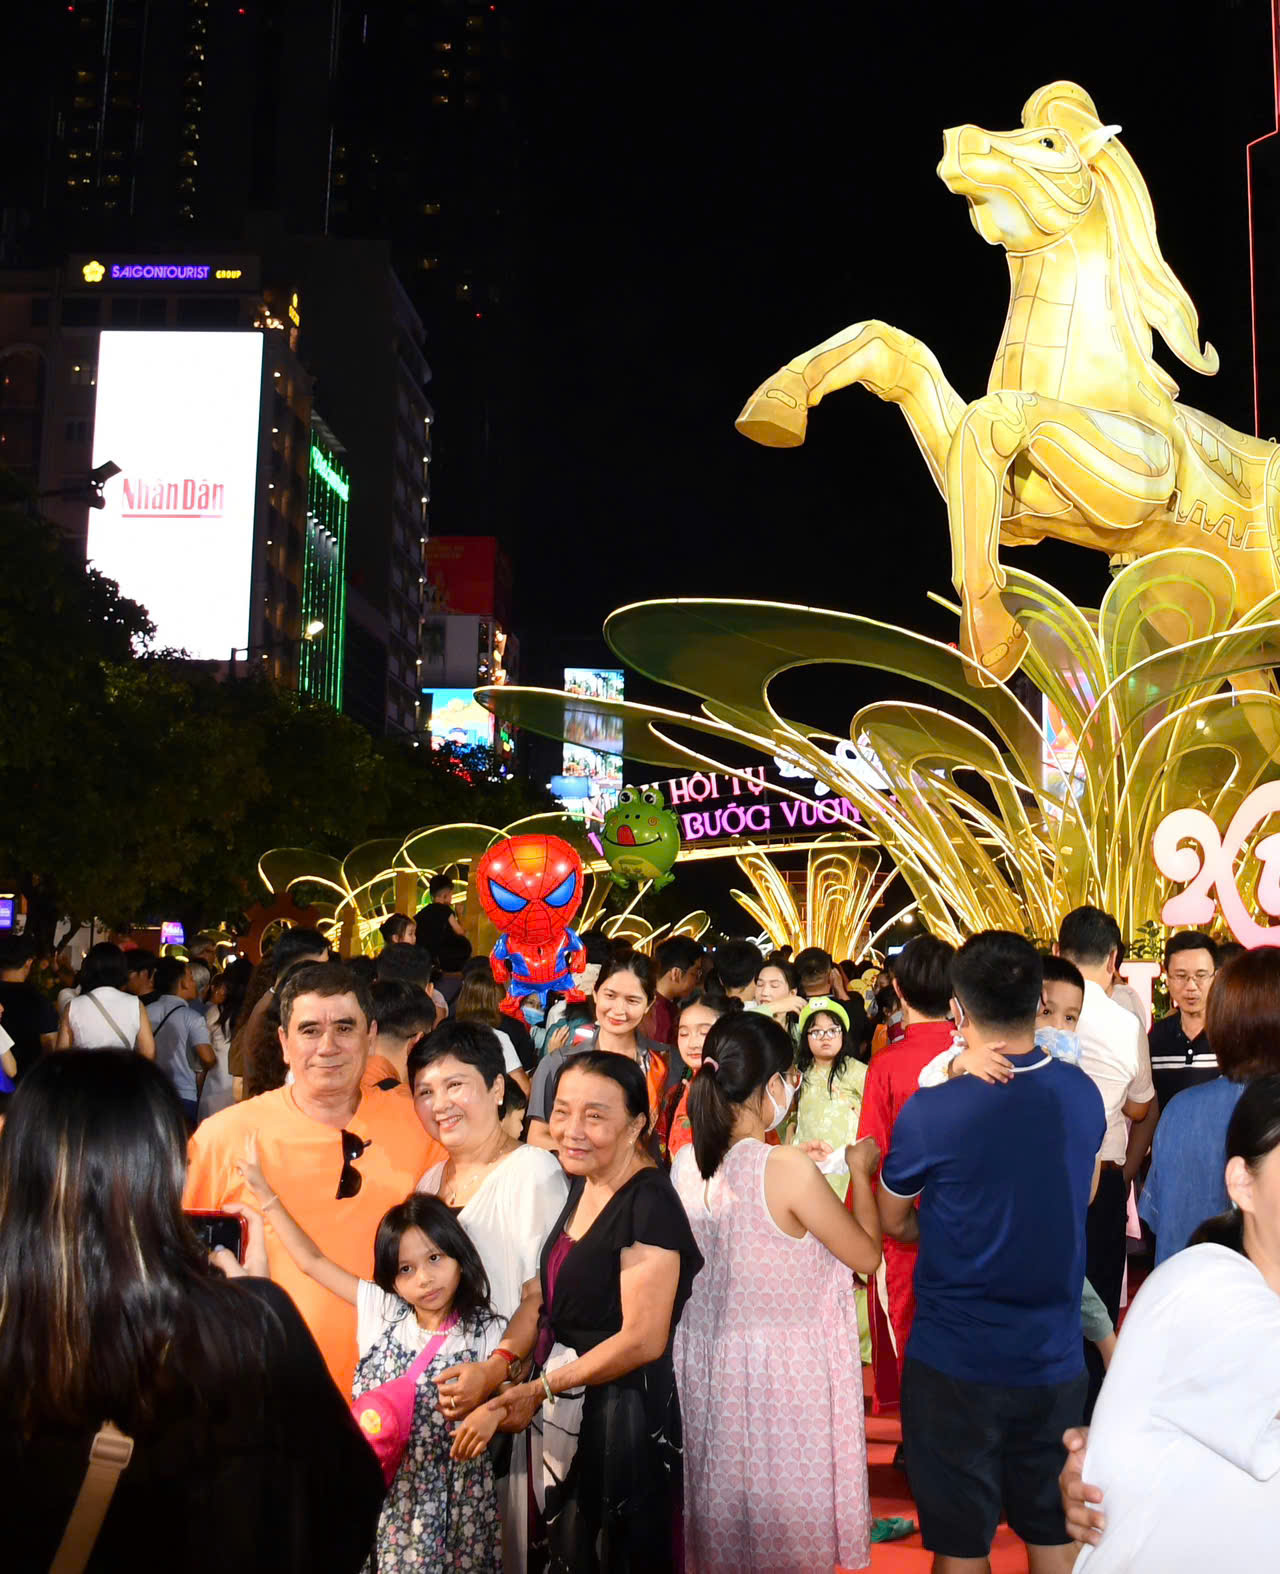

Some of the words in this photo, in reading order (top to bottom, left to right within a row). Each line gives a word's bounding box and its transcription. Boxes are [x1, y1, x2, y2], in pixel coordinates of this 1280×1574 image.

[111, 264, 211, 280] SAIGONTOURIST
[215, 270, 242, 279] GROUP
[668, 771, 720, 805] HỘI
[682, 802, 771, 841] BƯỚC
